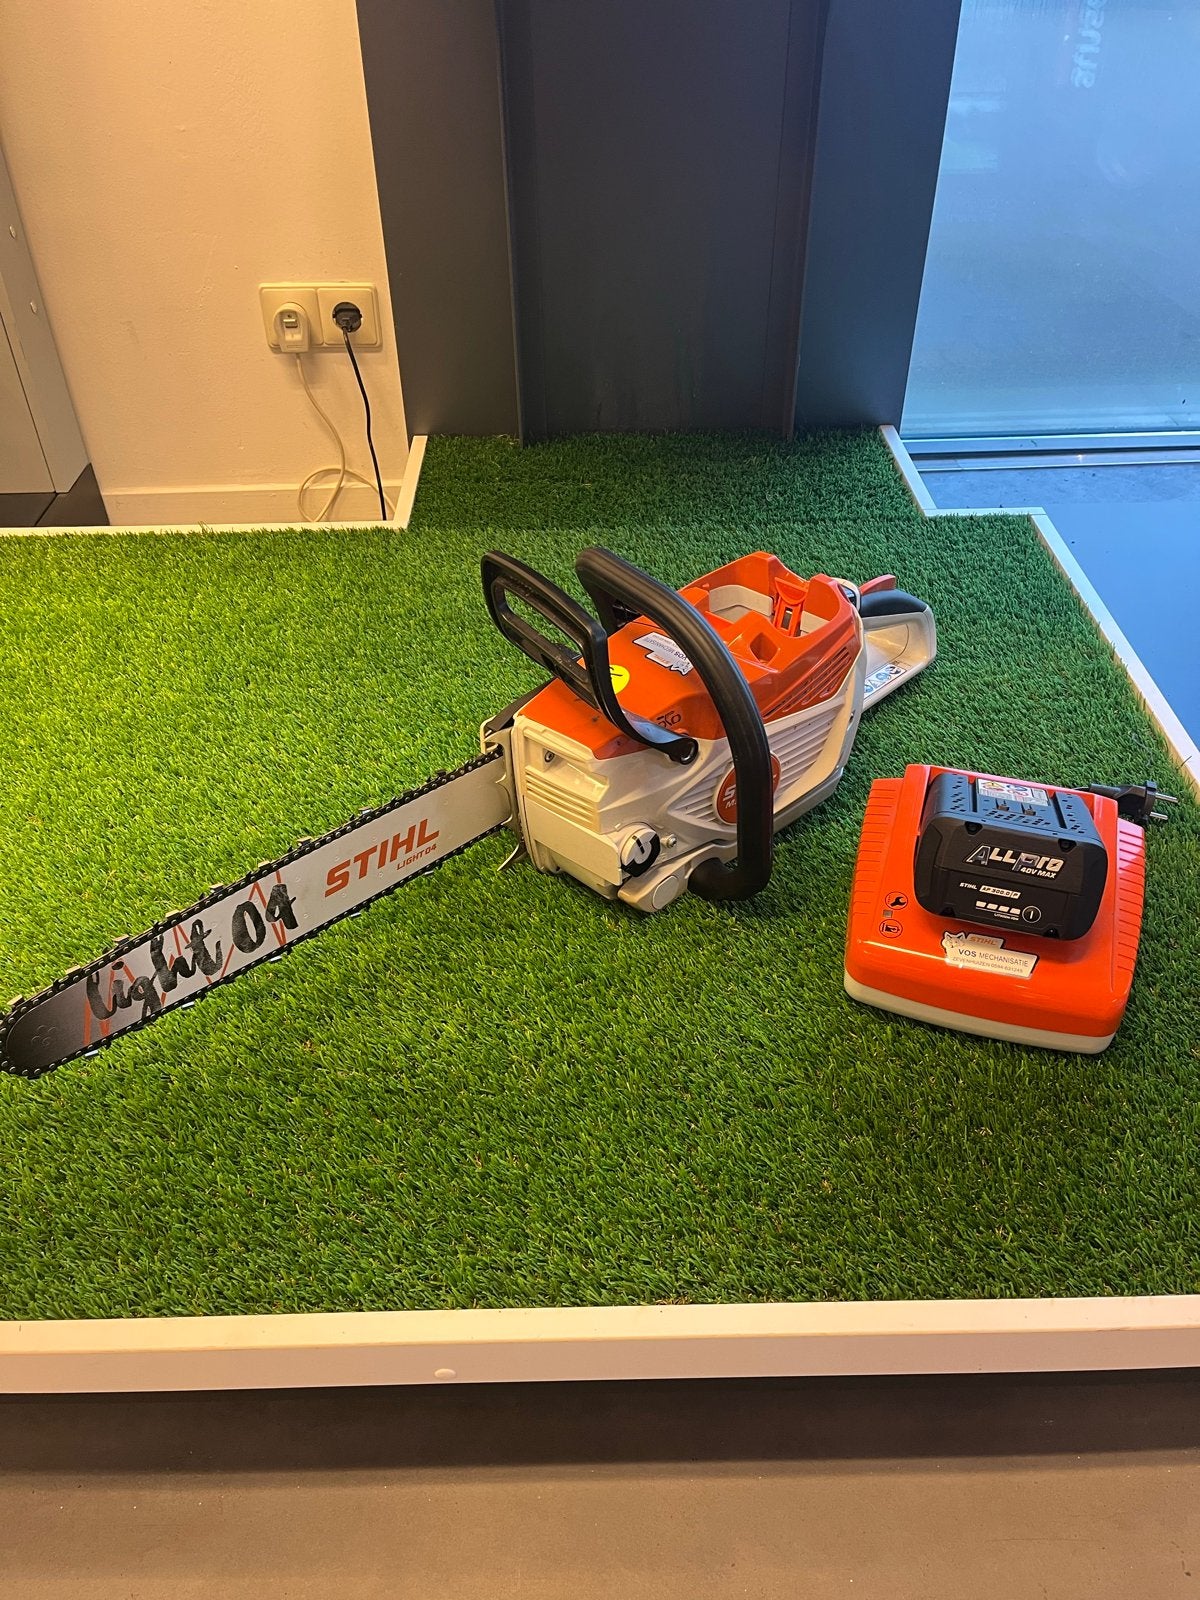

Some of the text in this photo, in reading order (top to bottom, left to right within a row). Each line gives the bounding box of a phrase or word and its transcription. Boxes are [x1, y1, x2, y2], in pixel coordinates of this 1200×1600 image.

[325, 818, 440, 898] STIHL
[1037, 870, 1057, 879] MAX
[959, 882, 978, 890] STIHL
[232, 883, 299, 954] 04
[970, 936, 997, 946] STIHL
[958, 948, 1029, 967] VOS MECHANISATIE
